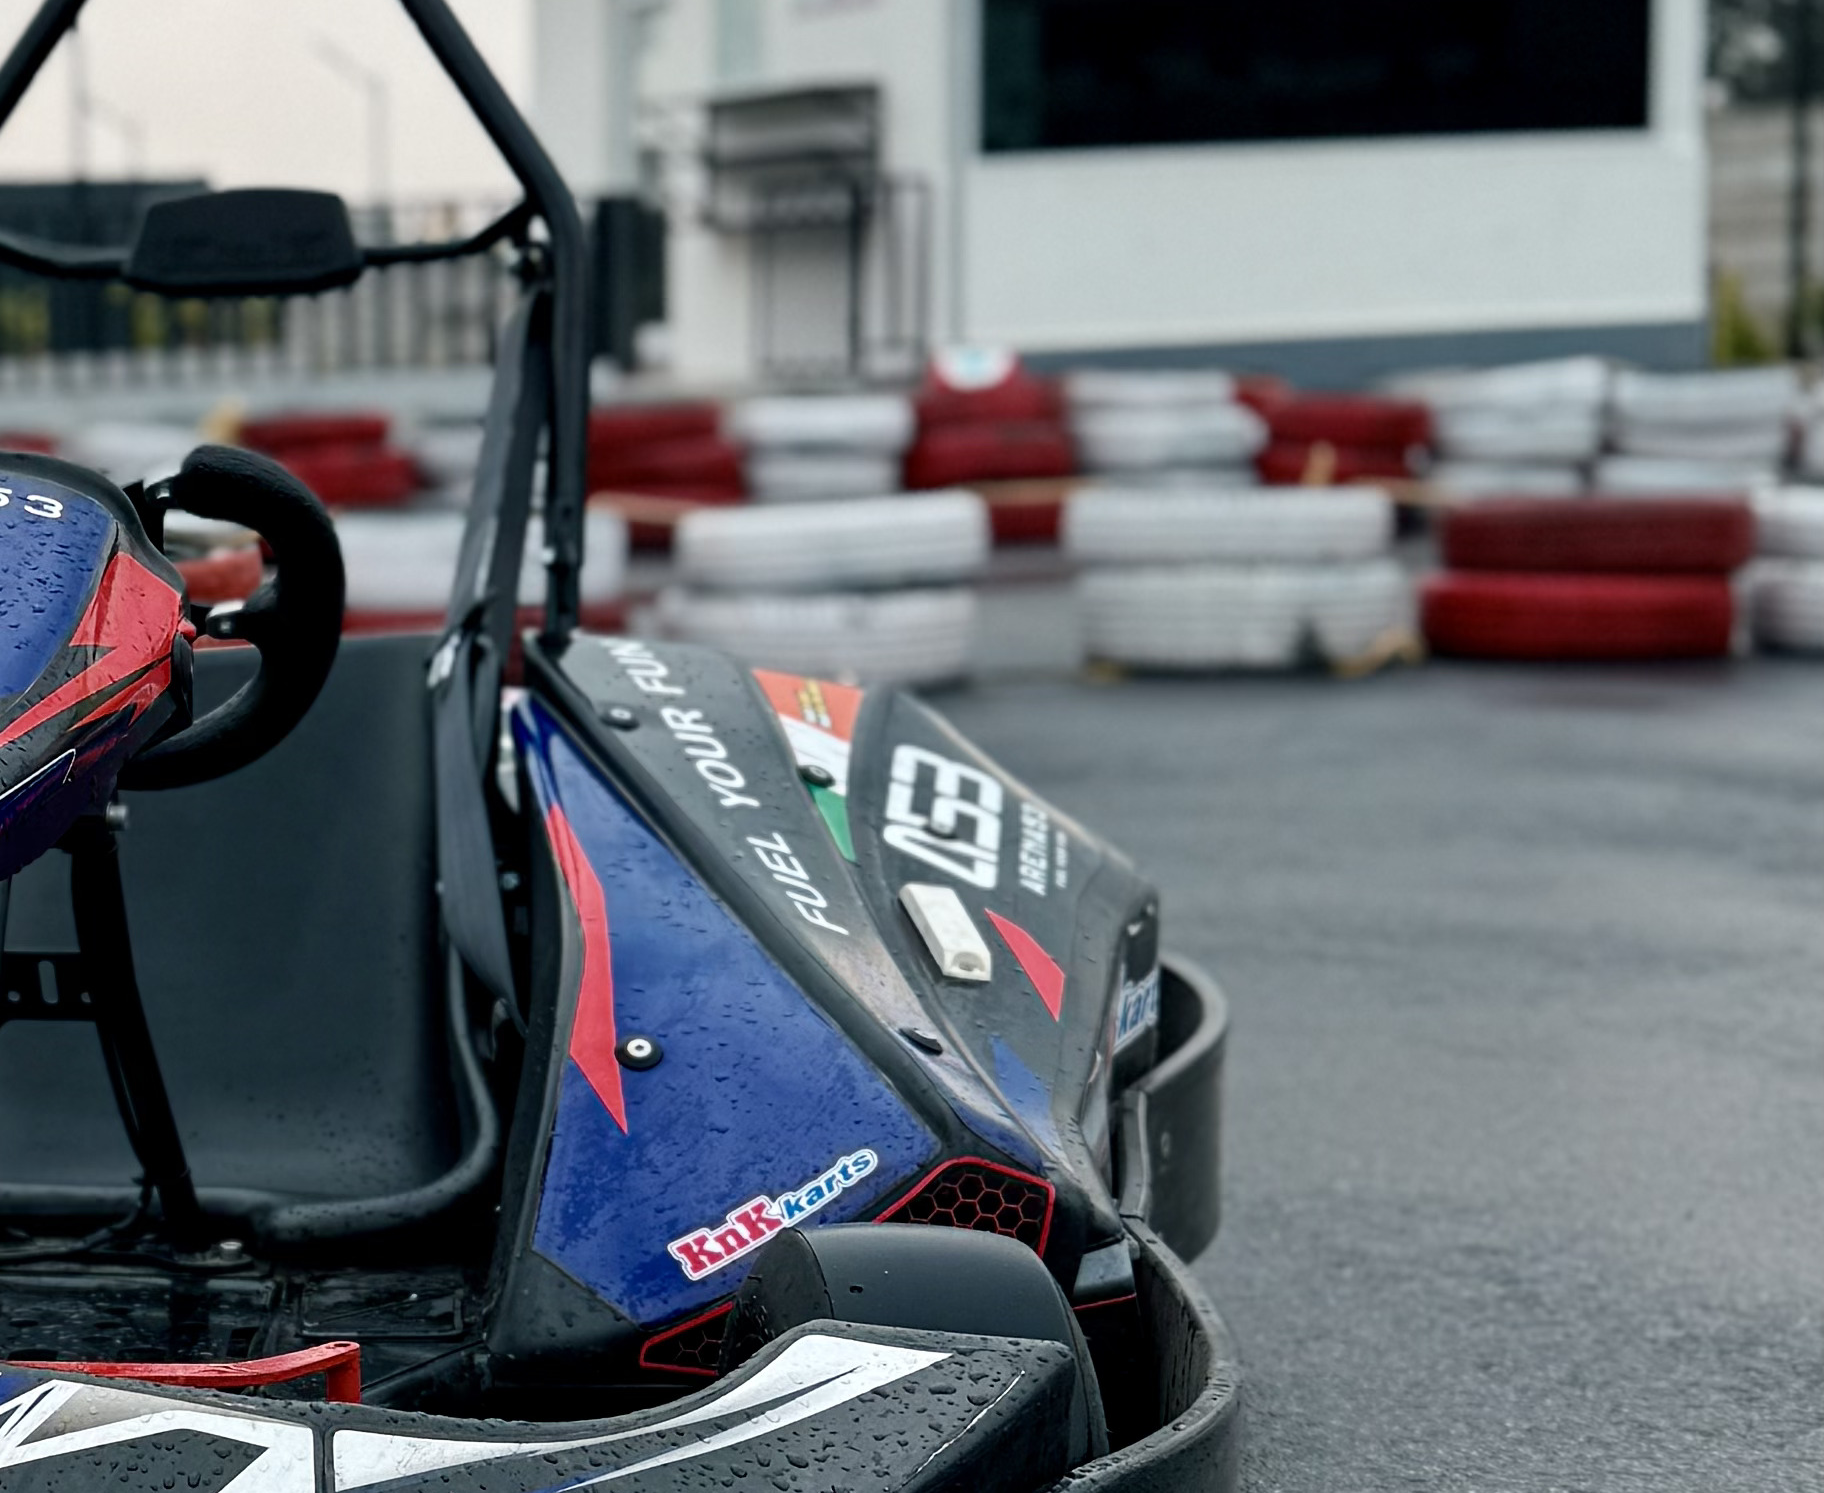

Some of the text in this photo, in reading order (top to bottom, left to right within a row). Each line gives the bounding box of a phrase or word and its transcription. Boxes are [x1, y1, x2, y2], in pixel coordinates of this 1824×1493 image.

[600, 639, 849, 936] FUEL YOUR FUN
[883, 744, 1004, 890] A53
[675, 1153, 871, 1275] KnK karts
